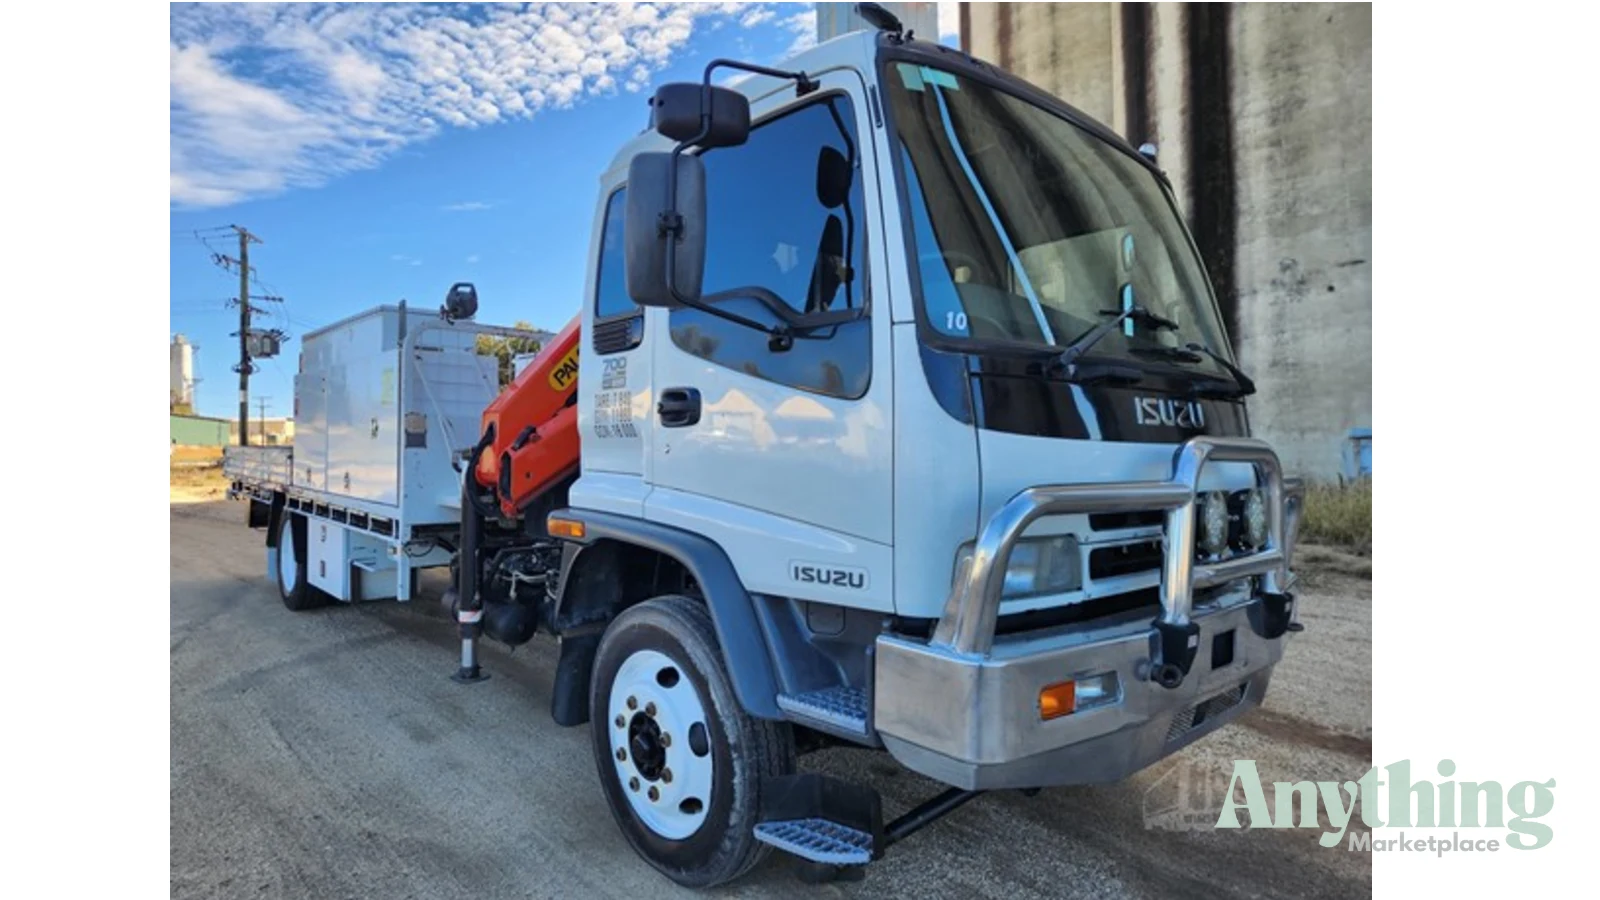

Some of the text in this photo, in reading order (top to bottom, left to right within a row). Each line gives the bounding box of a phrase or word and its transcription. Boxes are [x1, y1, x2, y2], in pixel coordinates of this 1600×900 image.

[945, 311, 967, 330] 10
[553, 348, 579, 387] PAL
[1134, 395, 1206, 428] ISUZU
[793, 565, 865, 588] ISUZU
